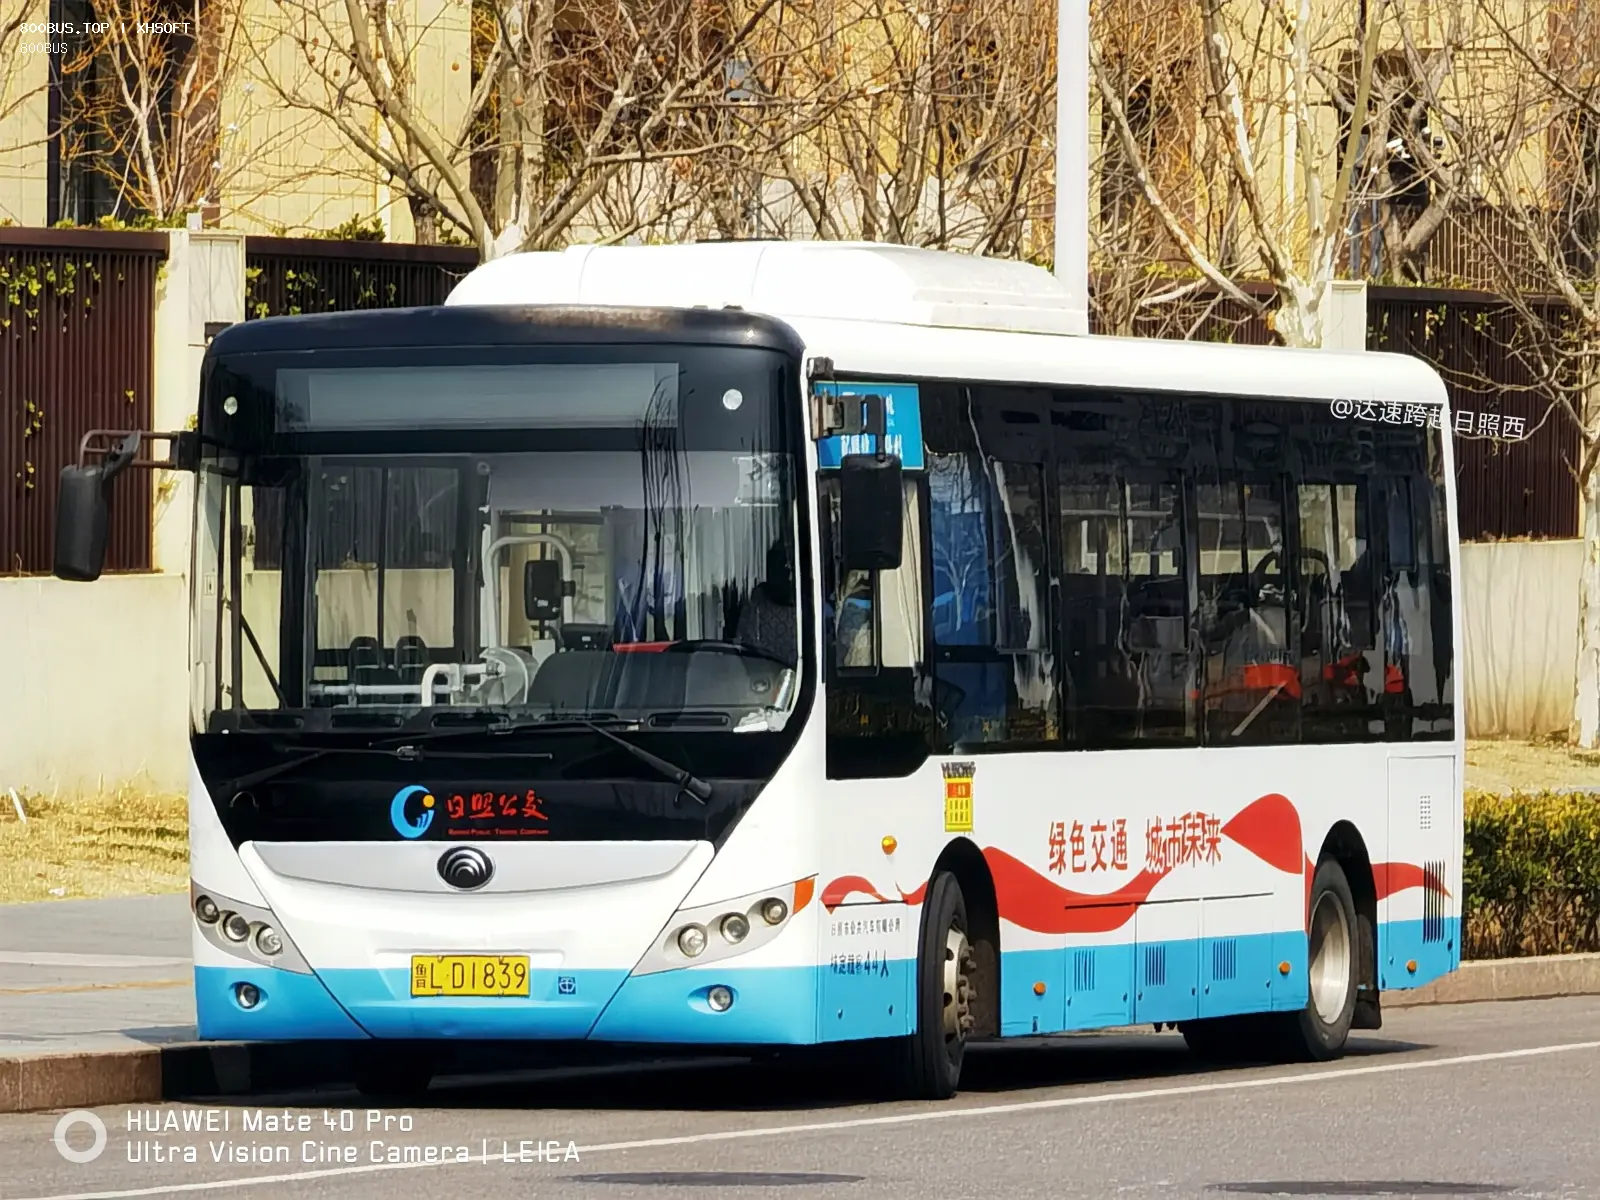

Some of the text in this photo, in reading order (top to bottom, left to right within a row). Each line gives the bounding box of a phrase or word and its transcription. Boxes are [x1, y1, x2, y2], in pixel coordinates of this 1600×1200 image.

[447, 789, 549, 821] 日照公交
[1048, 812, 1222, 875] 绿色交通 城市未来
